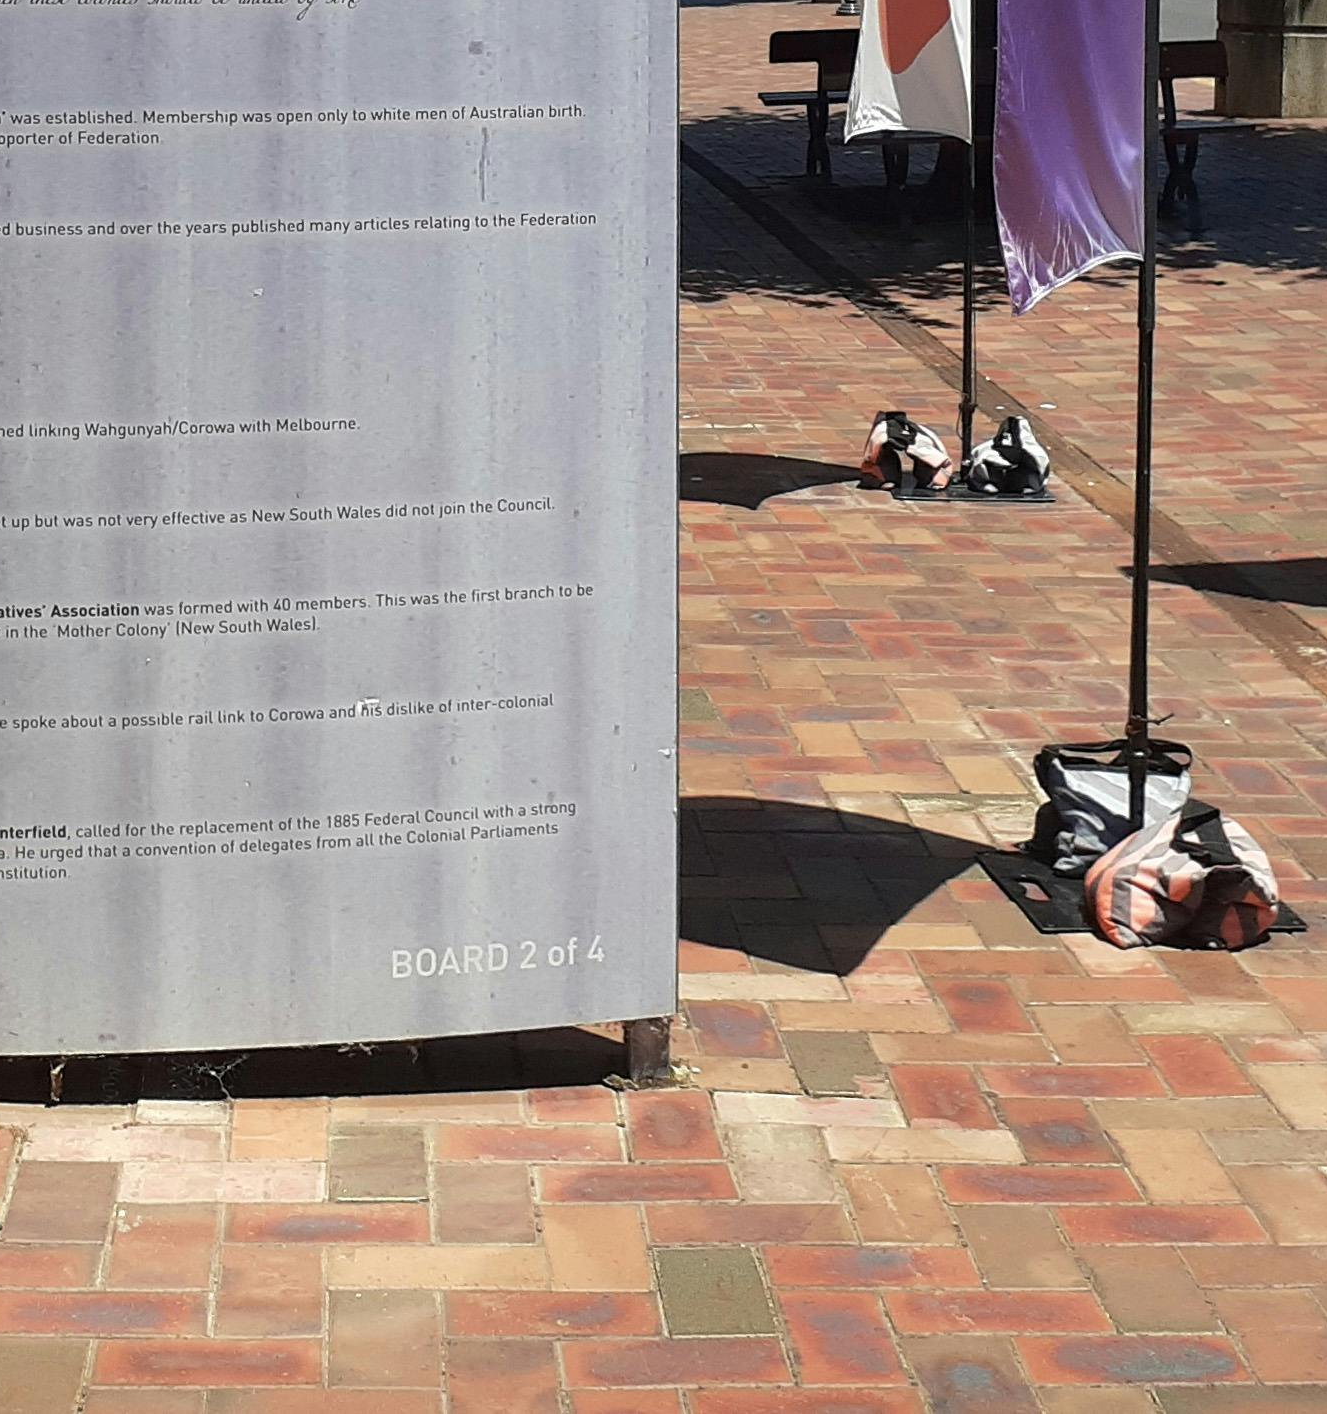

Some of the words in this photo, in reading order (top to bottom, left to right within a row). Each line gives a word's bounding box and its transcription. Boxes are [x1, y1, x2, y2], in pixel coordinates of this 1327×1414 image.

[391, 941, 509, 979] BOARD
[519, 940, 538, 970] 2
[547, 936, 579, 968] of
[586, 934, 606, 964] 4
